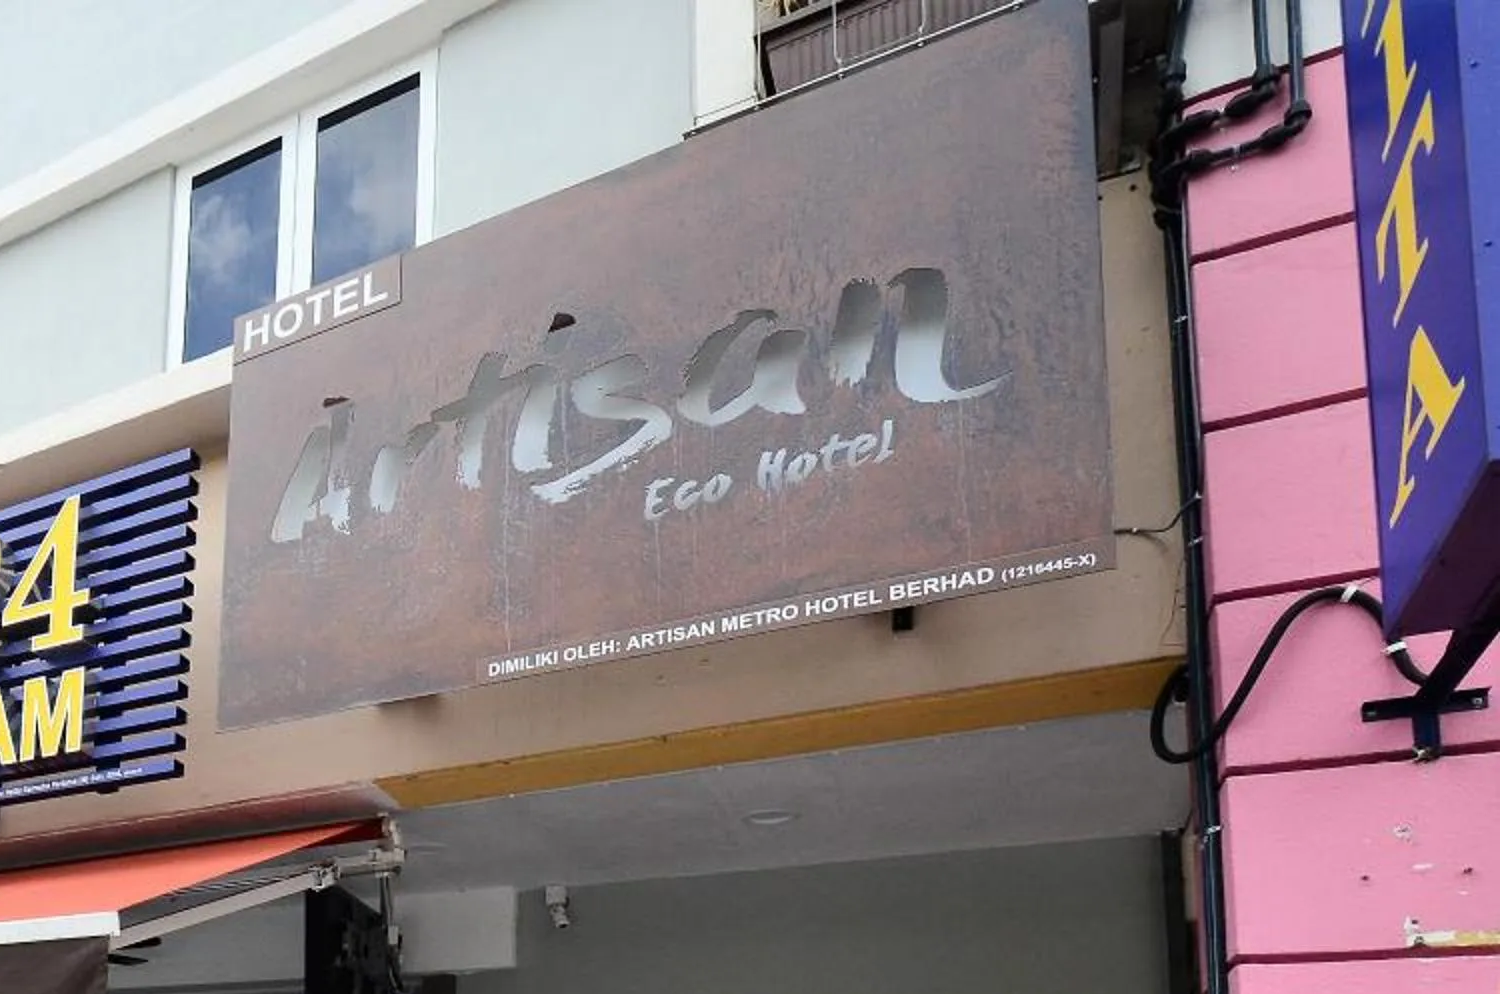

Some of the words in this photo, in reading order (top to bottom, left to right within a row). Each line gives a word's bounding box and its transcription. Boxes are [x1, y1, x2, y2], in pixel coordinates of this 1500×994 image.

[243, 271, 389, 352] HOTEL
[1361, 0, 1465, 529] ITA
[271, 266, 1014, 543] Artisan
[644, 473, 732, 522] Eco
[756, 419, 896, 491] Hotel
[488, 651, 559, 677] DIMILIKI
[563, 640, 622, 662] OLEH:
[625, 620, 716, 651] ARTISAN
[720, 604, 799, 633] METRO
[804, 589, 883, 617] HOTEL
[888, 567, 996, 601] BERHAD
